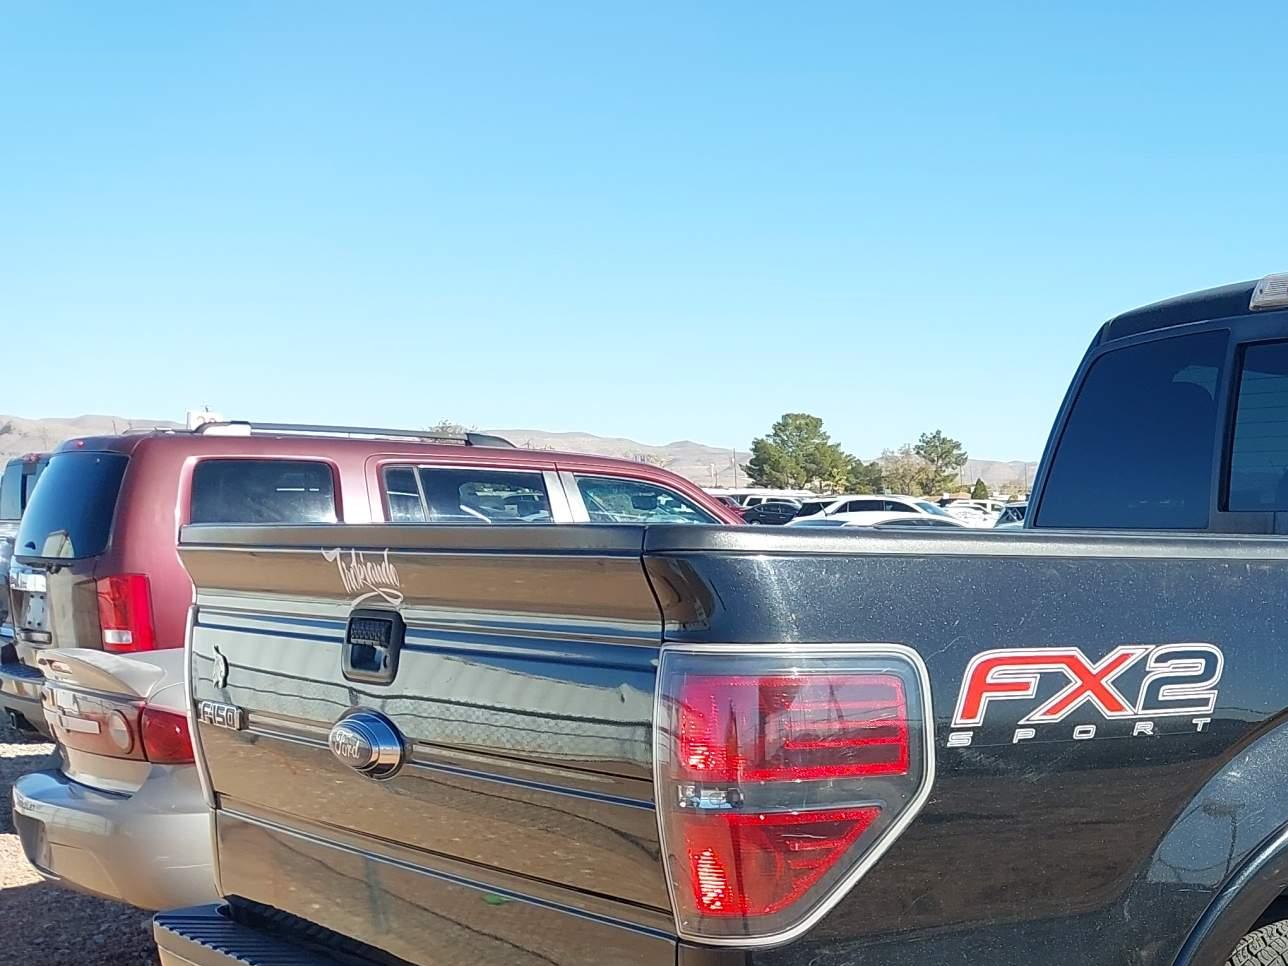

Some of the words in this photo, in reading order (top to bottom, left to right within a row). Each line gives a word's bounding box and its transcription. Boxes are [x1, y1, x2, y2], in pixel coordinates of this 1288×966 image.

[950, 642, 1225, 728] FX2
[334, 729, 361, 759] Ford
[946, 717, 1212, 748] SPORT
